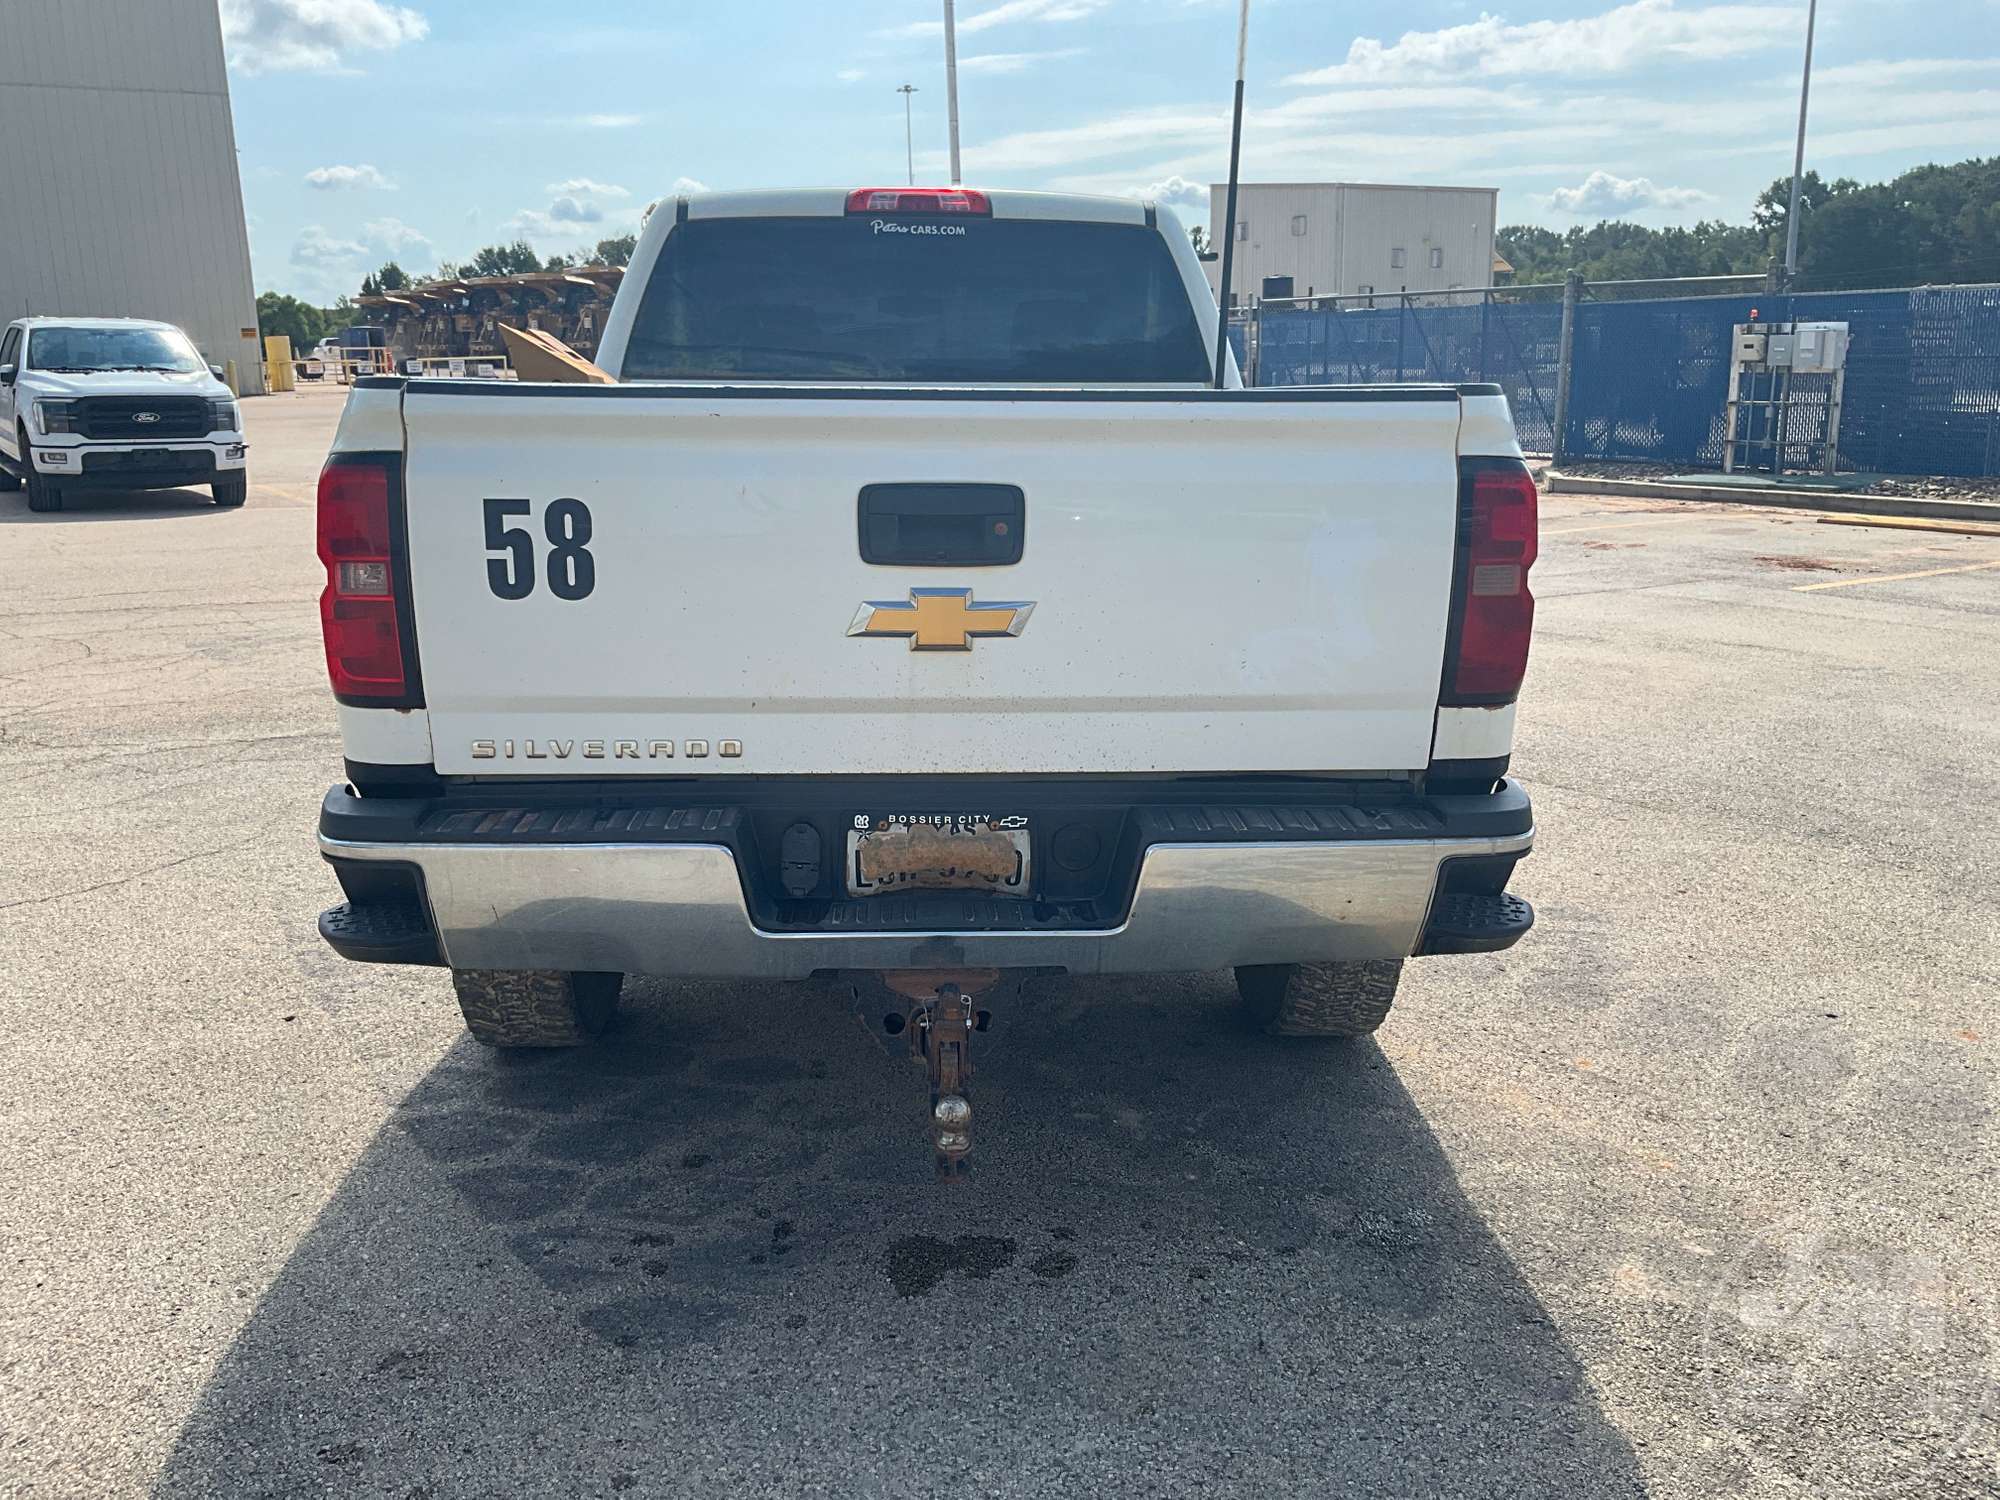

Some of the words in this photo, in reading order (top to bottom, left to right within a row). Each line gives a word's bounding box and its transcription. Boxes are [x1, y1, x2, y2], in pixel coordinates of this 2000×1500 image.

[910, 225, 966, 236] CARS.COM
[483, 497, 596, 601] 58
[471, 739, 743, 759] SILVERADO
[888, 814, 952, 824] BOSSIER
[958, 814, 991, 824] CITY
